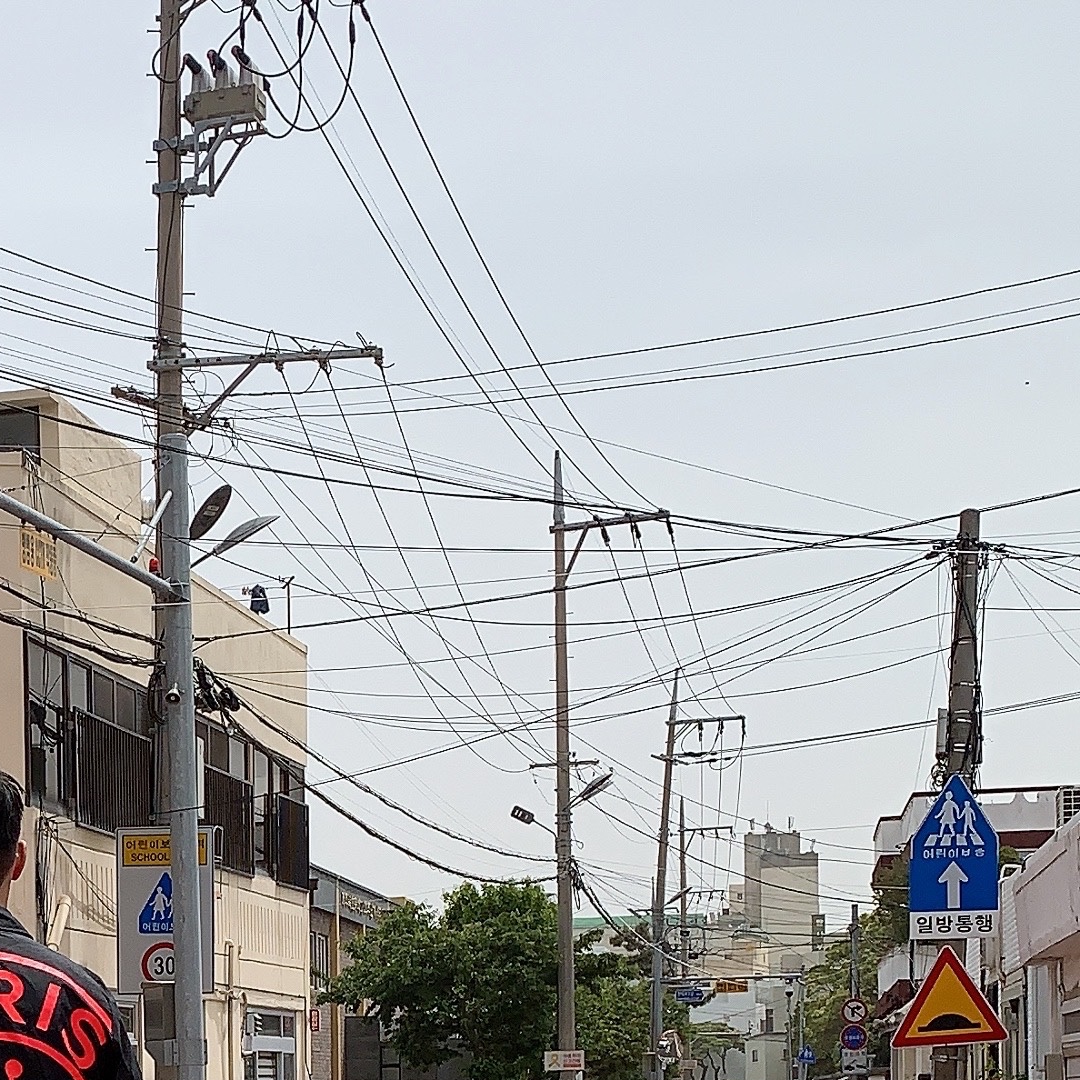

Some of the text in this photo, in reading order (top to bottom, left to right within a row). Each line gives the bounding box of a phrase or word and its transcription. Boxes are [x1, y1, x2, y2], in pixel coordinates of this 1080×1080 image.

[131, 852, 170, 862] SCHOOL
[142, 922, 174, 932] 어린이
[916, 914, 993, 934] 일방통행
[154, 956, 175, 976] 30
